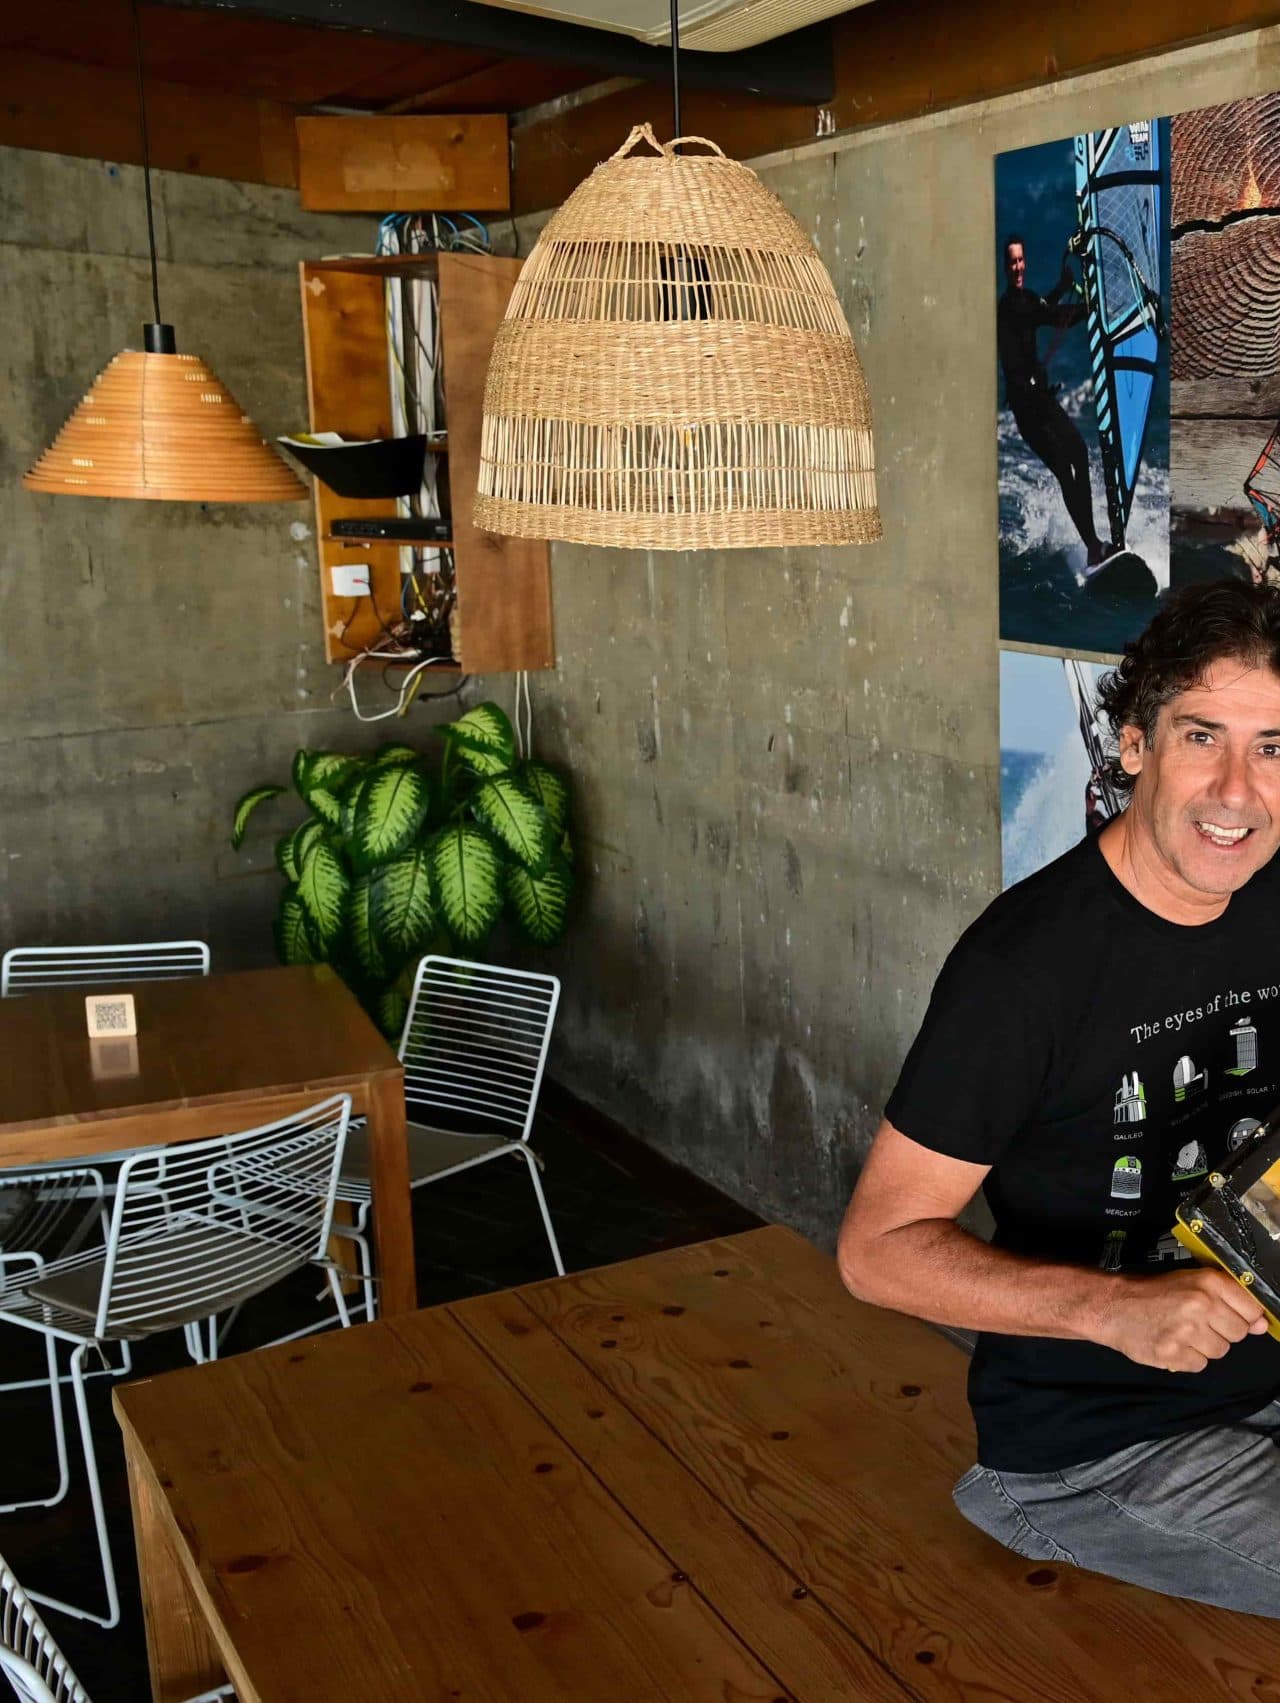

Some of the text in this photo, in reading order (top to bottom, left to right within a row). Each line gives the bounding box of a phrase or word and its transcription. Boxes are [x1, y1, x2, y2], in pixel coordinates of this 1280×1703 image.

[1130, 1021, 1161, 1044] The
[1164, 1006, 1204, 1031] eyes
[1206, 994, 1222, 1014] of
[1224, 989, 1251, 1008] the
[1246, 1086, 1269, 1095] SOLAR
[1113, 1131, 1144, 1141] GALILEO
